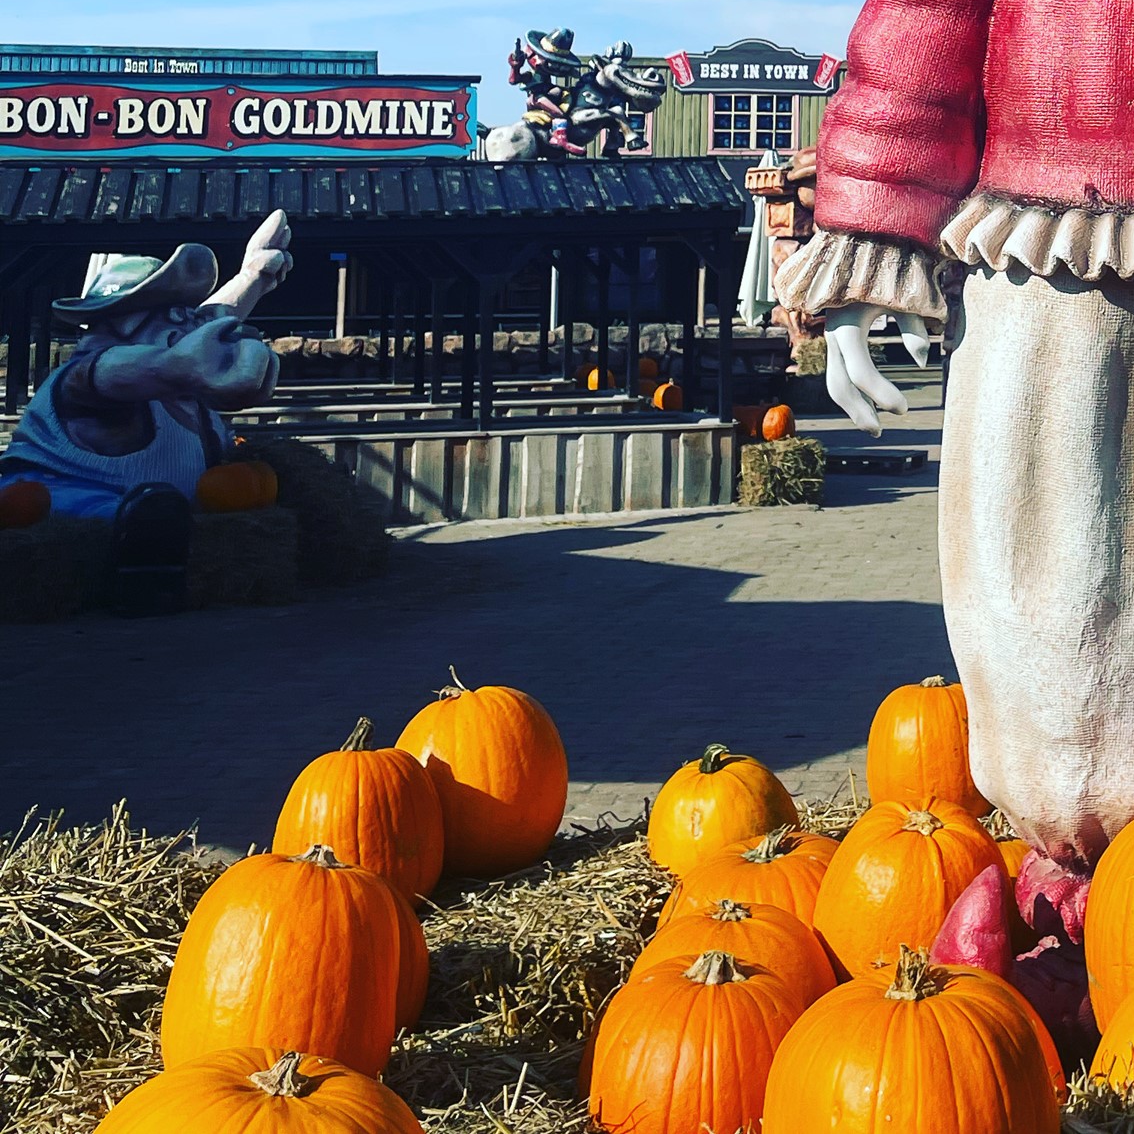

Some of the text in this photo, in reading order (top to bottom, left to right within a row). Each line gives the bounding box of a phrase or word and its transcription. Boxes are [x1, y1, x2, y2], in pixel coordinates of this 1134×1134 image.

[169, 59, 198, 74] Town
[700, 63, 808, 80] BEST IN TOWN
[234, 98, 453, 136] GOLDMINE
